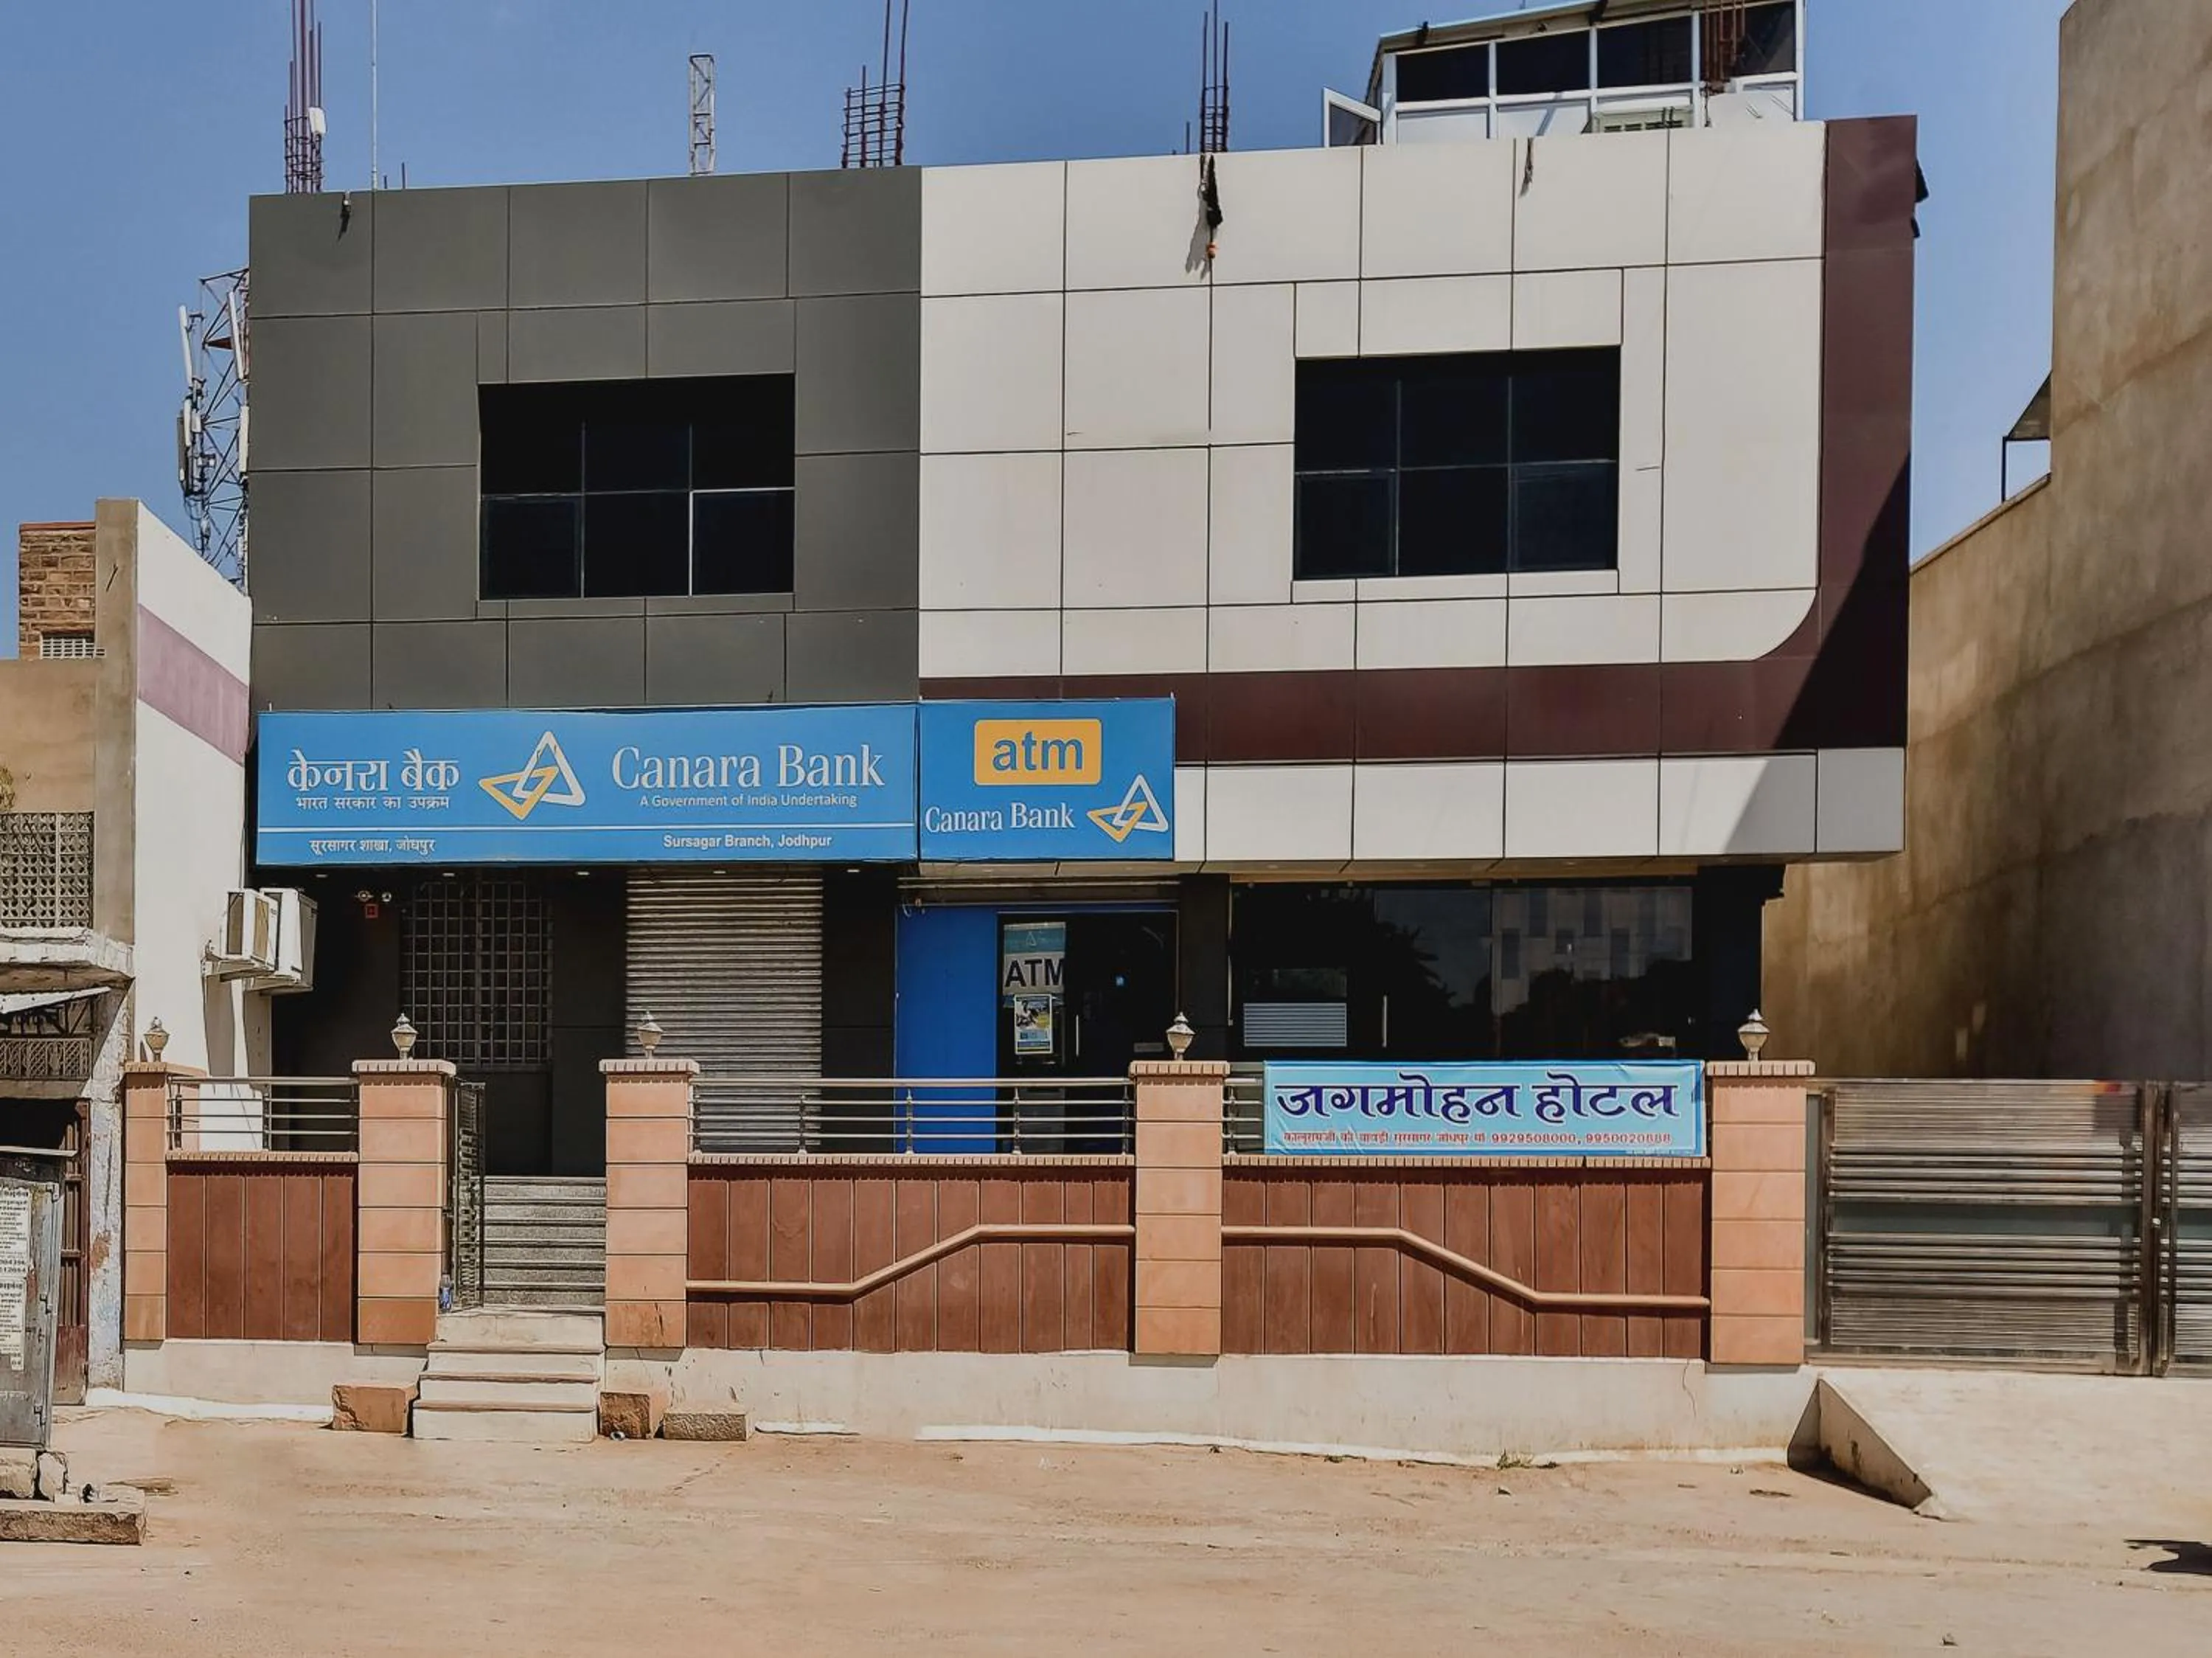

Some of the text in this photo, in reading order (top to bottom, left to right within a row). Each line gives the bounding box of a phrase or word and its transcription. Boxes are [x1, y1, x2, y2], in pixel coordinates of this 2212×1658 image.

[992, 731, 1084, 771] atm
[288, 749, 389, 792] केनरा
[612, 743, 885, 790] Canara Bank
[296, 796, 450, 809] भारत सरकार का उपक्रम
[640, 793, 858, 808] A Government of India Undertaking
[925, 802, 1077, 833] Canara Bank
[309, 839, 356, 856] सूरसागर
[397, 835, 436, 856] जोधपुर
[664, 834, 832, 850] Sursagar Branch, Jodhpur
[1004, 958, 1064, 988] ATM
[1274, 1072, 1680, 1125] जगमोहन होटल
